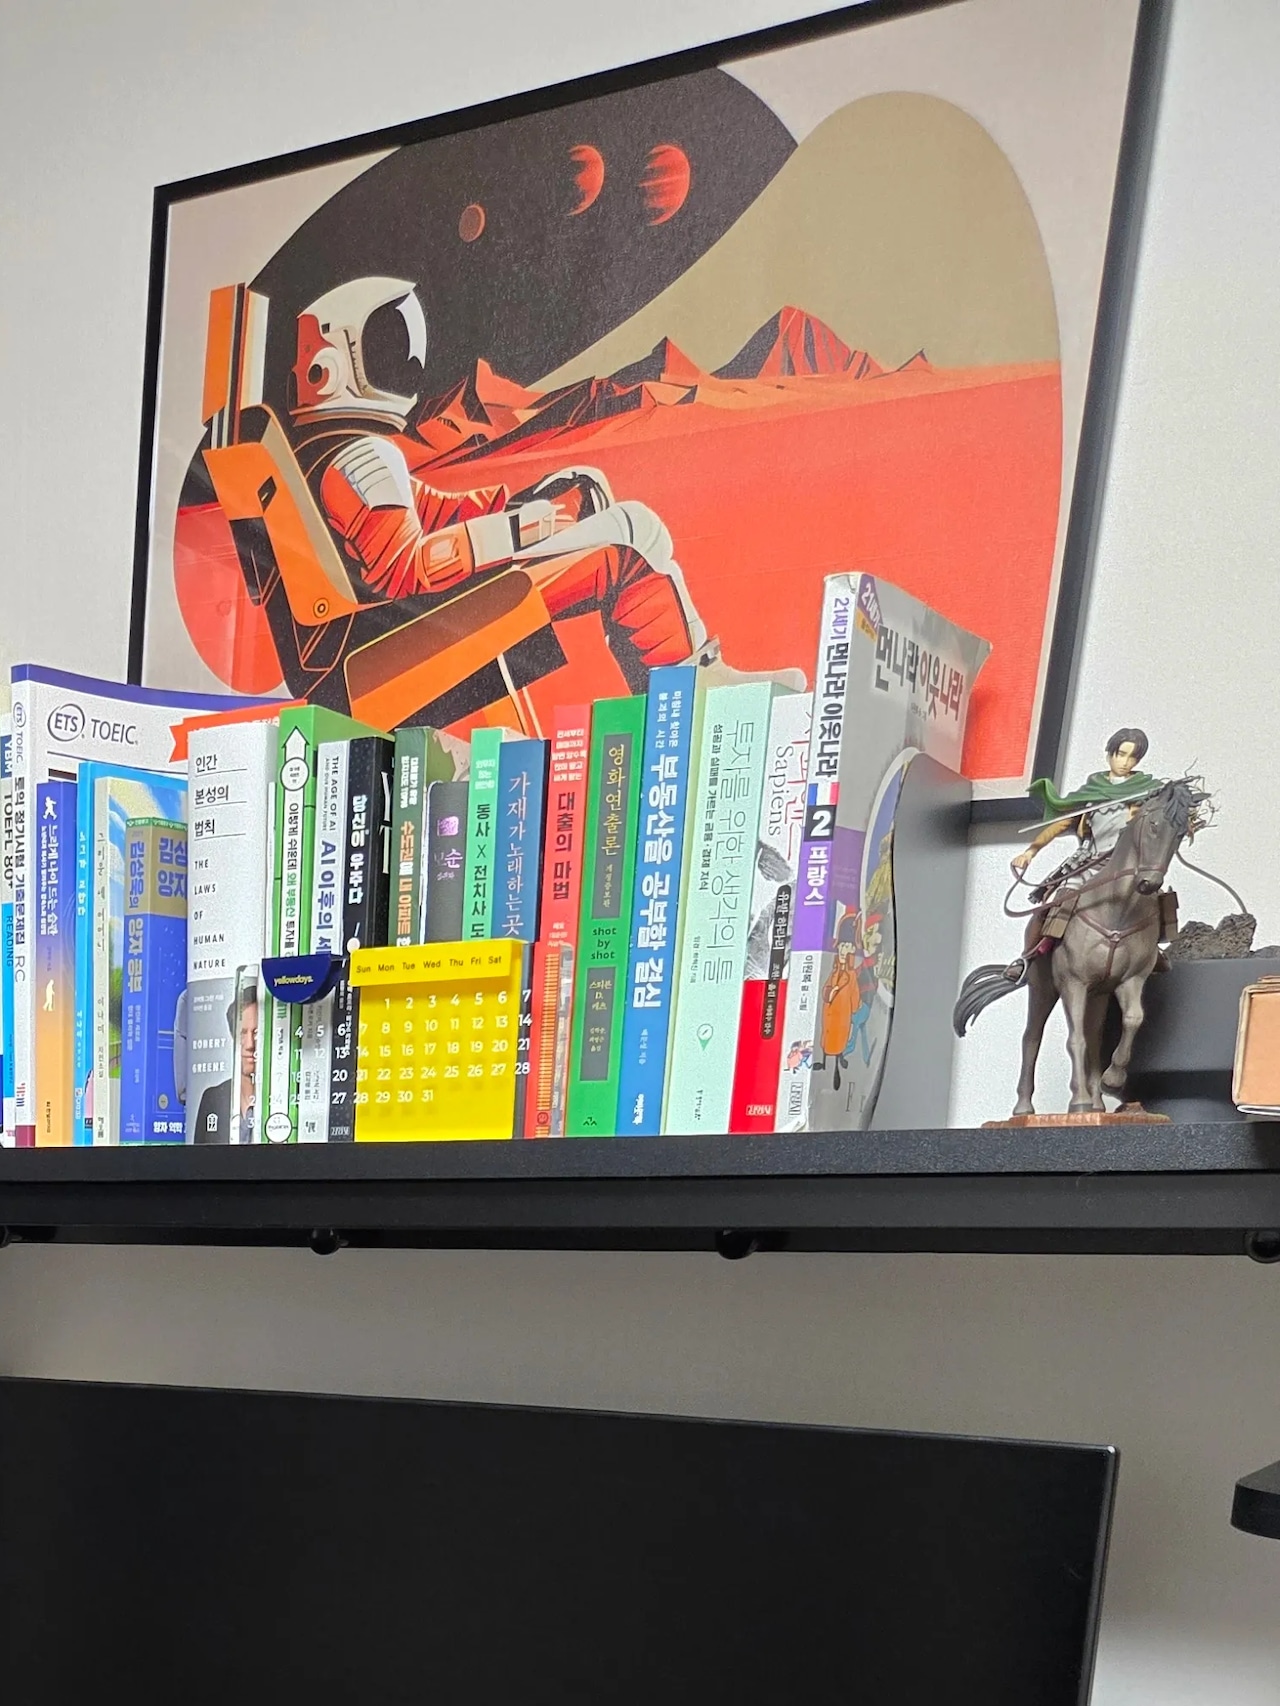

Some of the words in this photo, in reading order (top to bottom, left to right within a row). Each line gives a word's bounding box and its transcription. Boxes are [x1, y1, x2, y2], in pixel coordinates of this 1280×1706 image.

[830, 597, 850, 641] 21세기
[823, 642, 850, 698] 먼나라
[875, 624, 919, 694] 먼나라
[920, 650, 964, 721] 이웃나라
[671, 690, 682, 717] 마침내
[54, 712, 78, 733] ETS
[91, 718, 137, 745] TOEIC
[711, 723, 723, 754] 성공과
[815, 703, 843, 778] 이웃나라
[2, 738, 13, 773] YBM
[16, 732, 24, 764] TOEIC
[720, 719, 755, 802] 투자를
[196, 754, 218, 773] 인간
[331, 756, 339, 775] THE
[707, 756, 720, 787] 실패를
[15, 777, 25, 805] 토익
[195, 784, 229, 805] 본성의
[330, 778, 338, 799] AGE
[768, 745, 794, 836] Sapiens
[330, 804, 337, 817] OF
[507, 771, 531, 842] 가재가
[644, 754, 679, 865] 부동산을
[704, 790, 717, 820] 가르는
[4, 792, 13, 850] TOEFL
[195, 819, 216, 837] 법칙
[288, 803, 299, 837] 이렇게
[329, 820, 337, 831] AI
[351, 795, 368, 848] 당신이
[475, 803, 490, 838] 동사
[555, 791, 575, 853] 대출의
[810, 810, 831, 837] 2
[15, 811, 25, 868] 정기시험
[48, 824, 59, 859] 느리게
[399, 821, 415, 876] 수도권에
[715, 809, 746, 863] 위한
[194, 858, 209, 869] THE
[287, 838, 298, 870] 쉬운데
[320, 840, 336, 864] AI
[48, 861, 58, 884] 나이
[128, 841, 145, 908] 김상욱의
[286, 872, 296, 886] 왜
[348, 853, 365, 905] 우주다
[399, 878, 413, 892] 내
[505, 842, 524, 912] 노래하는
[553, 861, 572, 901] 마법
[698, 870, 710, 891] 지식
[803, 847, 828, 907] 프랑스
[47, 886, 58, 911] 드는
[194, 883, 217, 895] LAWS
[285, 888, 297, 918] 부동산
[317, 870, 335, 930] 이후의
[471, 864, 488, 916] 전치사
[775, 891, 790, 914] 유발
[15, 874, 25, 945] 기출문제집
[194, 911, 203, 920] OF
[397, 895, 412, 935] 아파트
[637, 871, 671, 951] 공부할
[706, 869, 742, 949] 생각의
[128, 918, 144, 954] 양자
[284, 920, 295, 949] 투자를
[502, 913, 524, 936] 곳
[593, 926, 617, 936] shot
[772, 917, 787, 950] 하라리
[6, 914, 14, 968] READING
[193, 934, 225, 945] HUMAN
[597, 938, 611, 949] by
[15, 956, 25, 982] RC
[193, 959, 226, 970] NATURE
[356, 965, 371, 974] Sun
[378, 963, 395, 972] Mon
[402, 962, 415, 971] Tue
[423, 960, 441, 969] Wed
[449, 959, 464, 967] Thu
[470, 957, 482, 966] Fri
[488, 956, 502, 965] Sat
[591, 950, 615, 960] shot
[802, 954, 814, 983] 이원복
[128, 958, 144, 993] 공부
[633, 957, 664, 1009] 결심
[703, 956, 733, 985] 틀
[385, 998, 390, 1009] 1
[406, 997, 413, 1009] 2
[428, 995, 437, 1007] 3
[450, 994, 460, 1006] 4
[474, 992, 484, 1005] 5
[498, 991, 507, 1004] 6
[522, 989, 531, 1002] 7
[294, 1025, 304, 1037] 4
[316, 1024, 325, 1036] 5
[337, 1024, 346, 1036] 6
[360, 1023, 368, 1035] 7
[381, 1022, 390, 1034] 8
[404, 1020, 413, 1033] 9
[425, 1019, 438, 1031] 10
[450, 1018, 460, 1030] 11
[472, 1017, 484, 1029] 12
[495, 1015, 508, 1028] 13
[518, 1014, 533, 1027] 14
[193, 1038, 227, 1050] ROBERT
[335, 1047, 347, 1059] 13
[356, 1046, 369, 1058] 14
[379, 1045, 391, 1057] 15
[401, 1044, 414, 1056] 16
[424, 1042, 437, 1055] 17
[447, 1041, 460, 1054] 18
[470, 1041, 483, 1053] 19
[491, 1040, 509, 1052] 20
[518, 1038, 531, 1051] 21
[192, 1061, 225, 1073] GREENE
[332, 1070, 348, 1082] 20
[356, 1069, 368, 1081] 21
[376, 1068, 391, 1080] 22
[399, 1067, 414, 1079] 23
[421, 1066, 437, 1078] 24
[444, 1065, 460, 1078] 25
[467, 1064, 484, 1077] 26
[490, 1063, 506, 1076] 27
[515, 1062, 531, 1075] 28
[331, 1092, 347, 1105] 27
[353, 1091, 369, 1104] 28
[375, 1091, 391, 1103] 29
[397, 1090, 413, 1102] 30
[421, 1089, 434, 1101] 31
